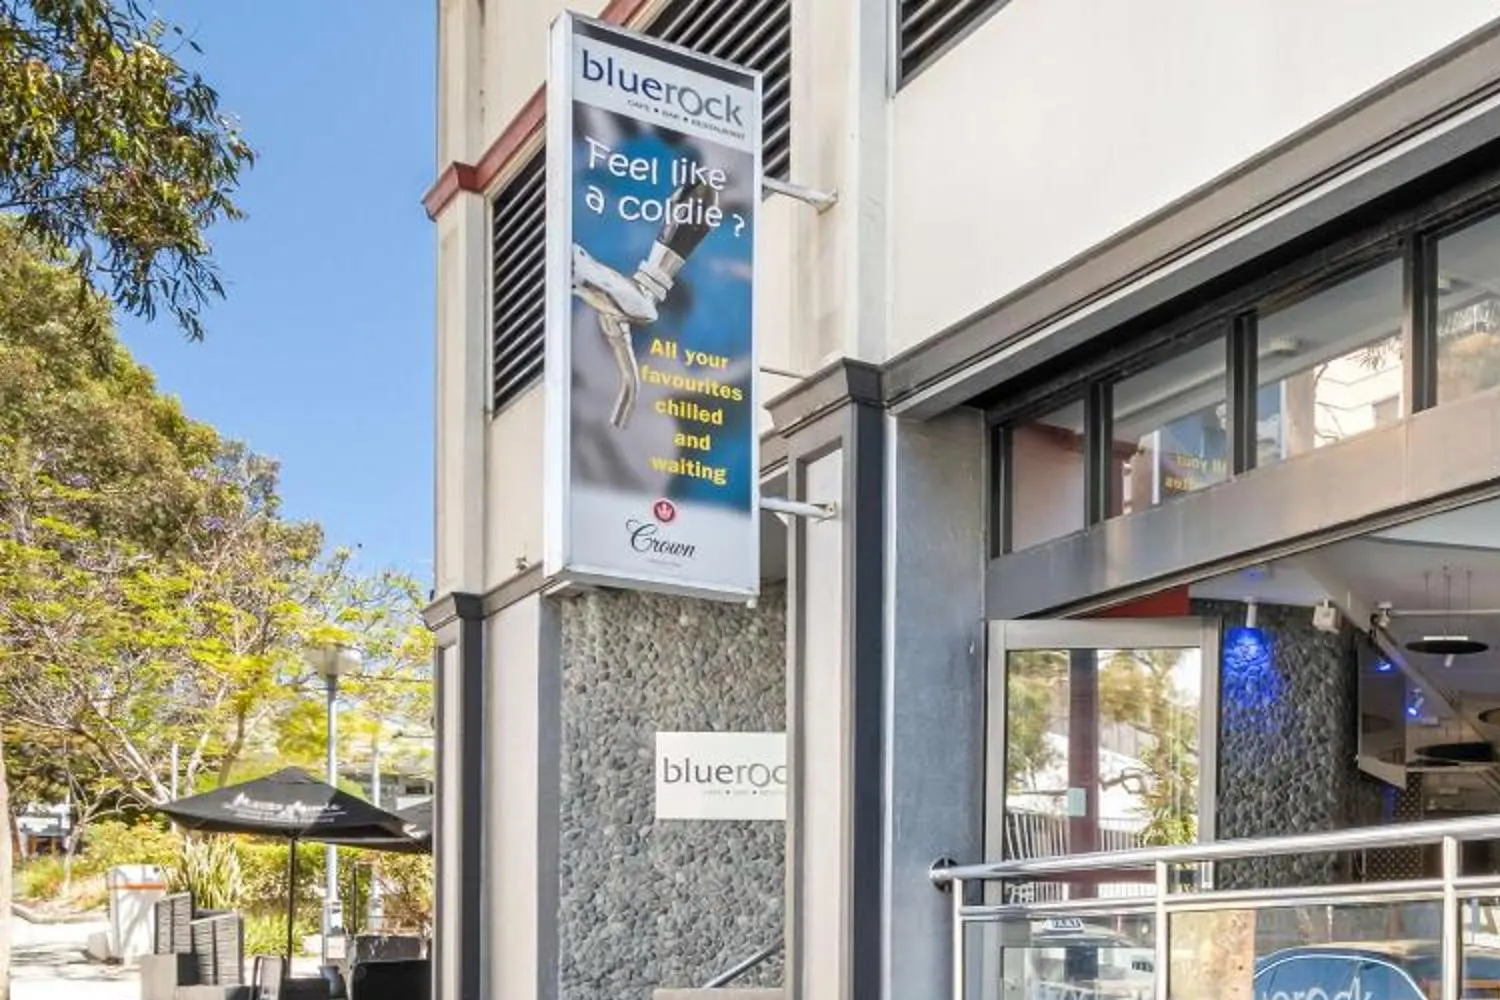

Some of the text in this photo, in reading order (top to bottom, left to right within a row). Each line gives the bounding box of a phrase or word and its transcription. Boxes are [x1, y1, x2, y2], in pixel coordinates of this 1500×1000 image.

[582, 48, 744, 127] bluerock
[584, 135, 726, 190] Feel like
[585, 185, 605, 214] a
[618, 195, 723, 228] coldie
[650, 338, 729, 371] All your
[639, 364, 744, 401] favourites
[655, 397, 724, 425] chilled
[672, 430, 711, 451] and
[650, 456, 727, 485] waiting
[625, 519, 698, 558] Crown
[662, 756, 787, 788] blueroc
